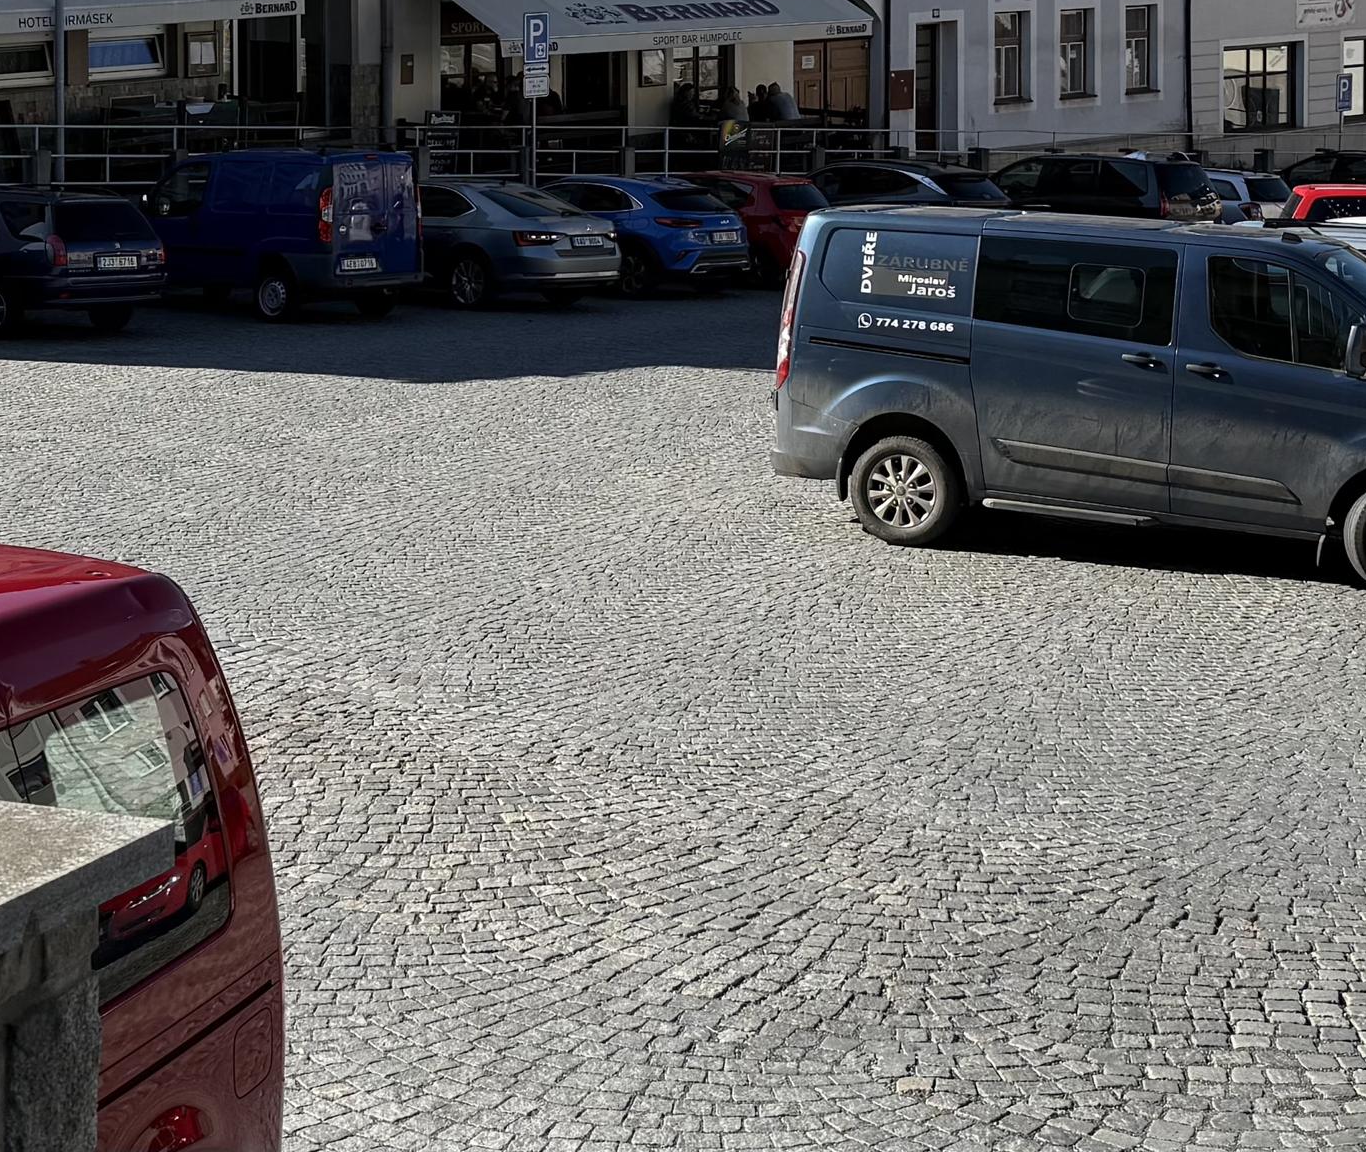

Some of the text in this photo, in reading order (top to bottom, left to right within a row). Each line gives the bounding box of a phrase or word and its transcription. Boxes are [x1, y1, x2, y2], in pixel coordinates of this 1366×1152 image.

[255, 1, 297, 14] BERNARD
[18, 11, 114, 29] HOTEL IRMÁSEK
[529, 18, 544, 48] P
[835, 24, 867, 35] BERNARD
[653, 31, 742, 46] SPORT BAR HUMPOLEC
[1340, 79, 1349, 101] P
[860, 231, 878, 294] DVEŘE
[877, 252, 969, 272] ZÁRUBNĚ
[897, 274, 946, 286] Miroslav
[907, 283, 956, 299] Jaroš
[875, 317, 955, 332] 774 278 686
